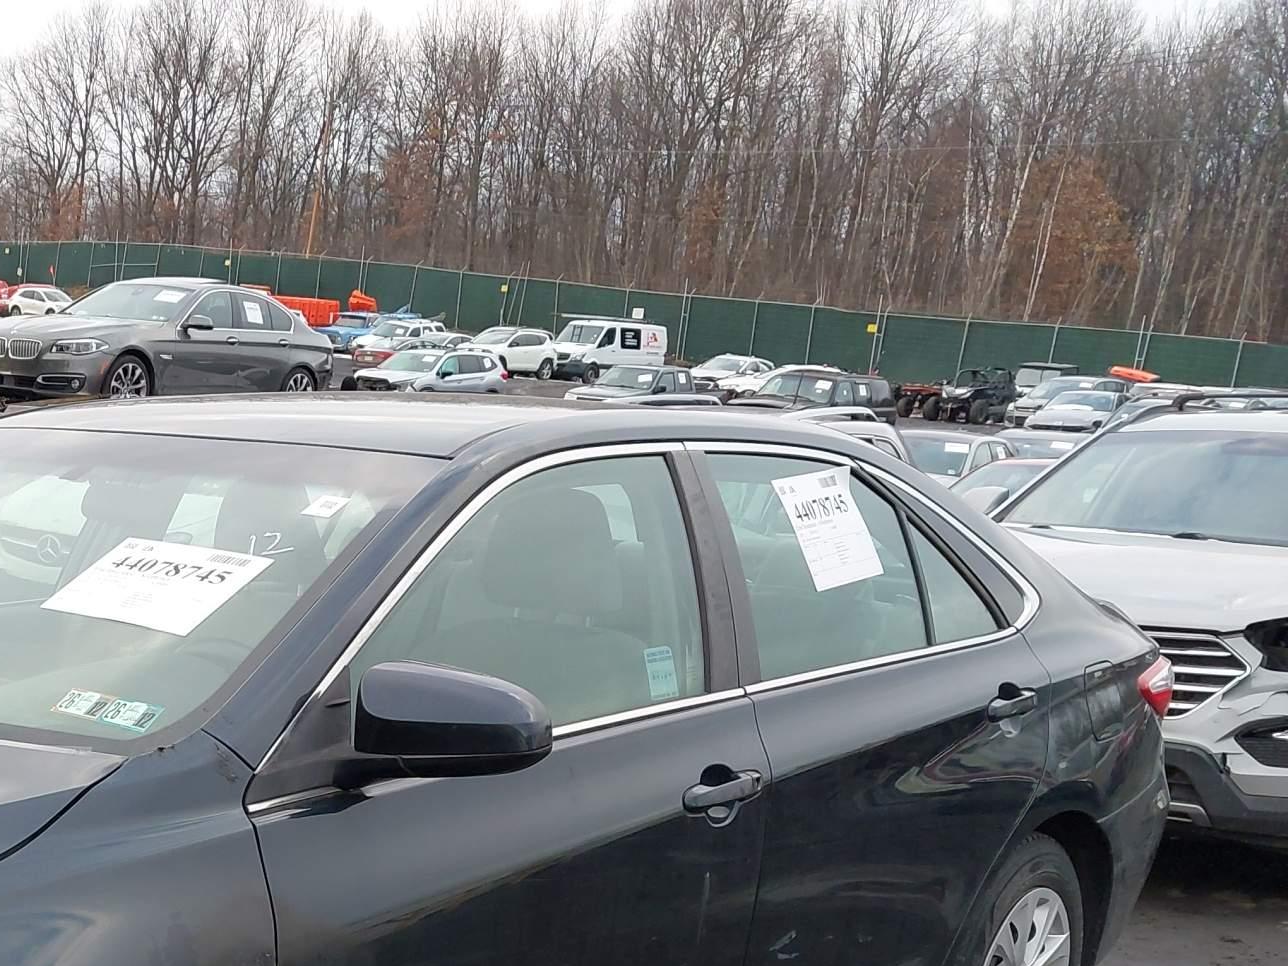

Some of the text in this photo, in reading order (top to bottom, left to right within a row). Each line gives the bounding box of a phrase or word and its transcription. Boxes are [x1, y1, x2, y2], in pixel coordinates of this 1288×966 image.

[793, 494, 849, 522] 44078745
[111, 555, 233, 585] 44078745
[58, 692, 81, 709] 26
[103, 701, 156, 728] 26 12
